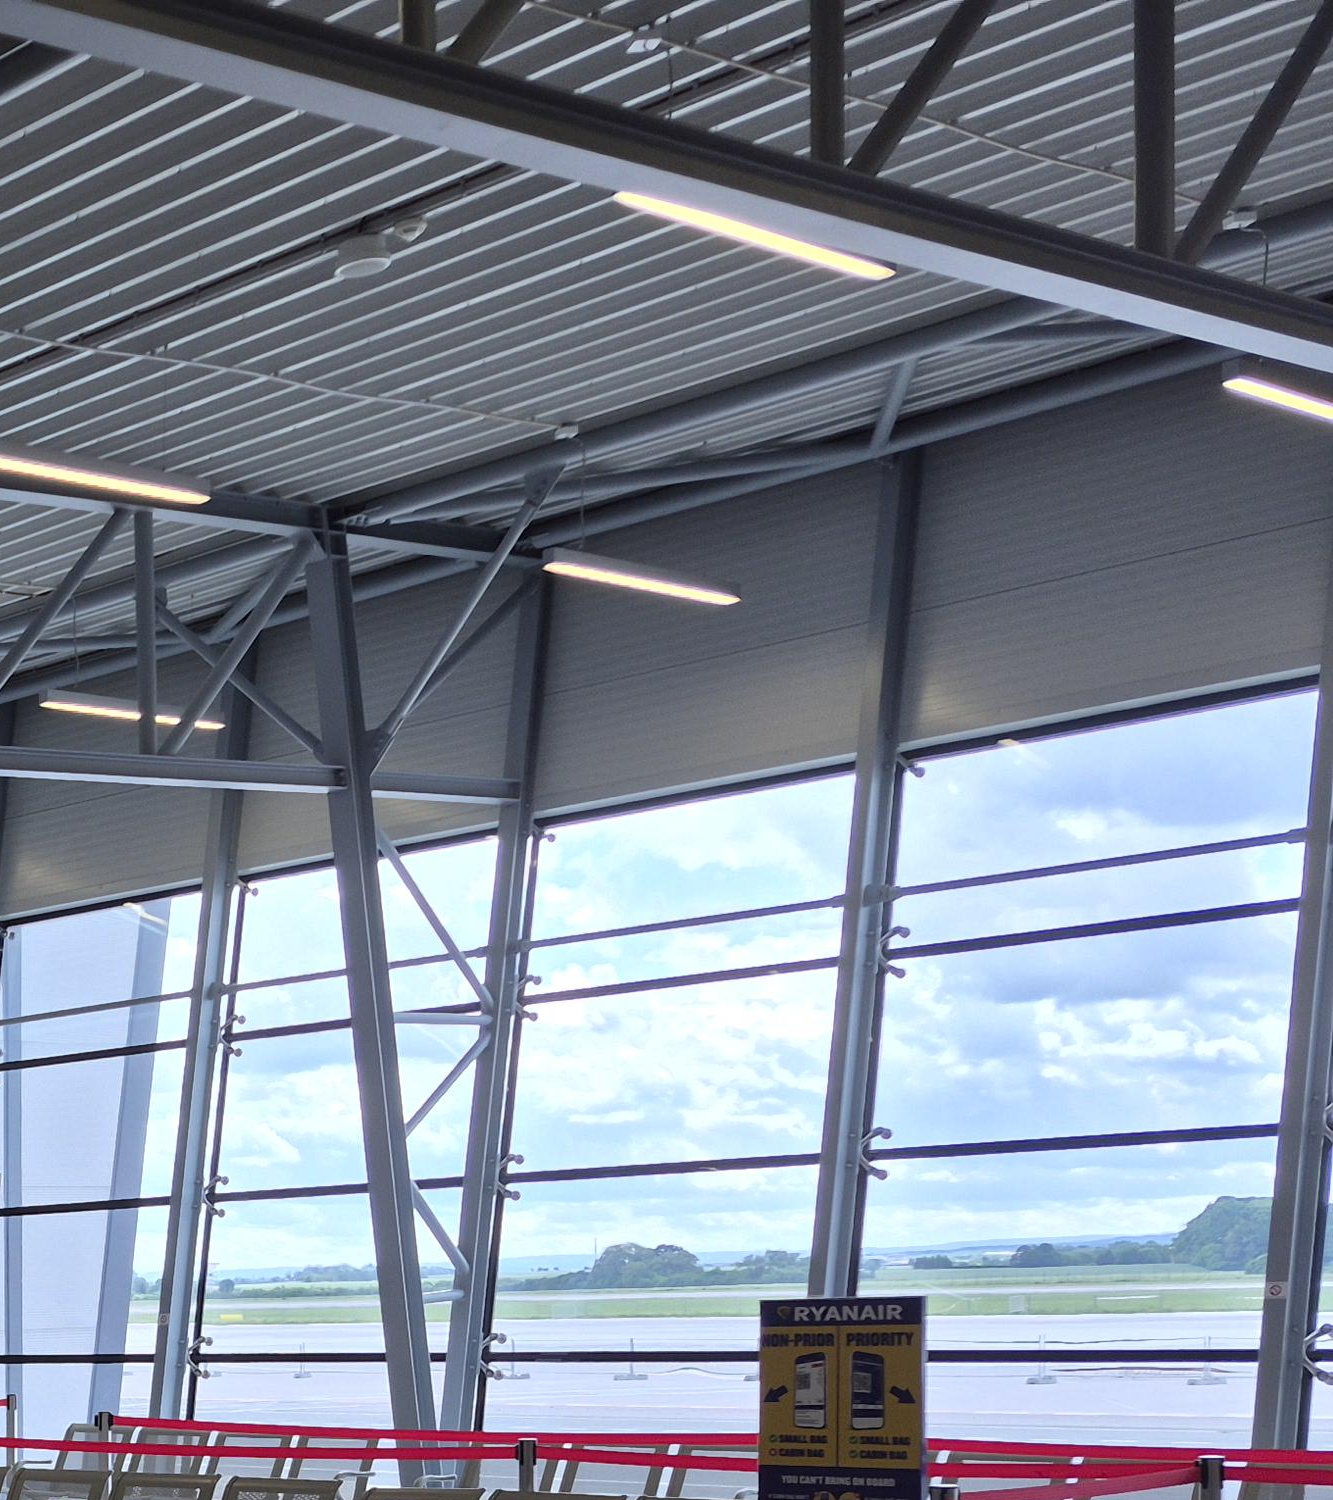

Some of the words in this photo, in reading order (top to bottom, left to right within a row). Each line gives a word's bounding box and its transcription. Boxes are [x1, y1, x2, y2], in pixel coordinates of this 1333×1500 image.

[794, 1304, 903, 1321] RYANAIR
[846, 1332, 914, 1346] PRIORITY
[781, 1475, 798, 1484] YOU
[799, 1476, 823, 1485] CAN'T
